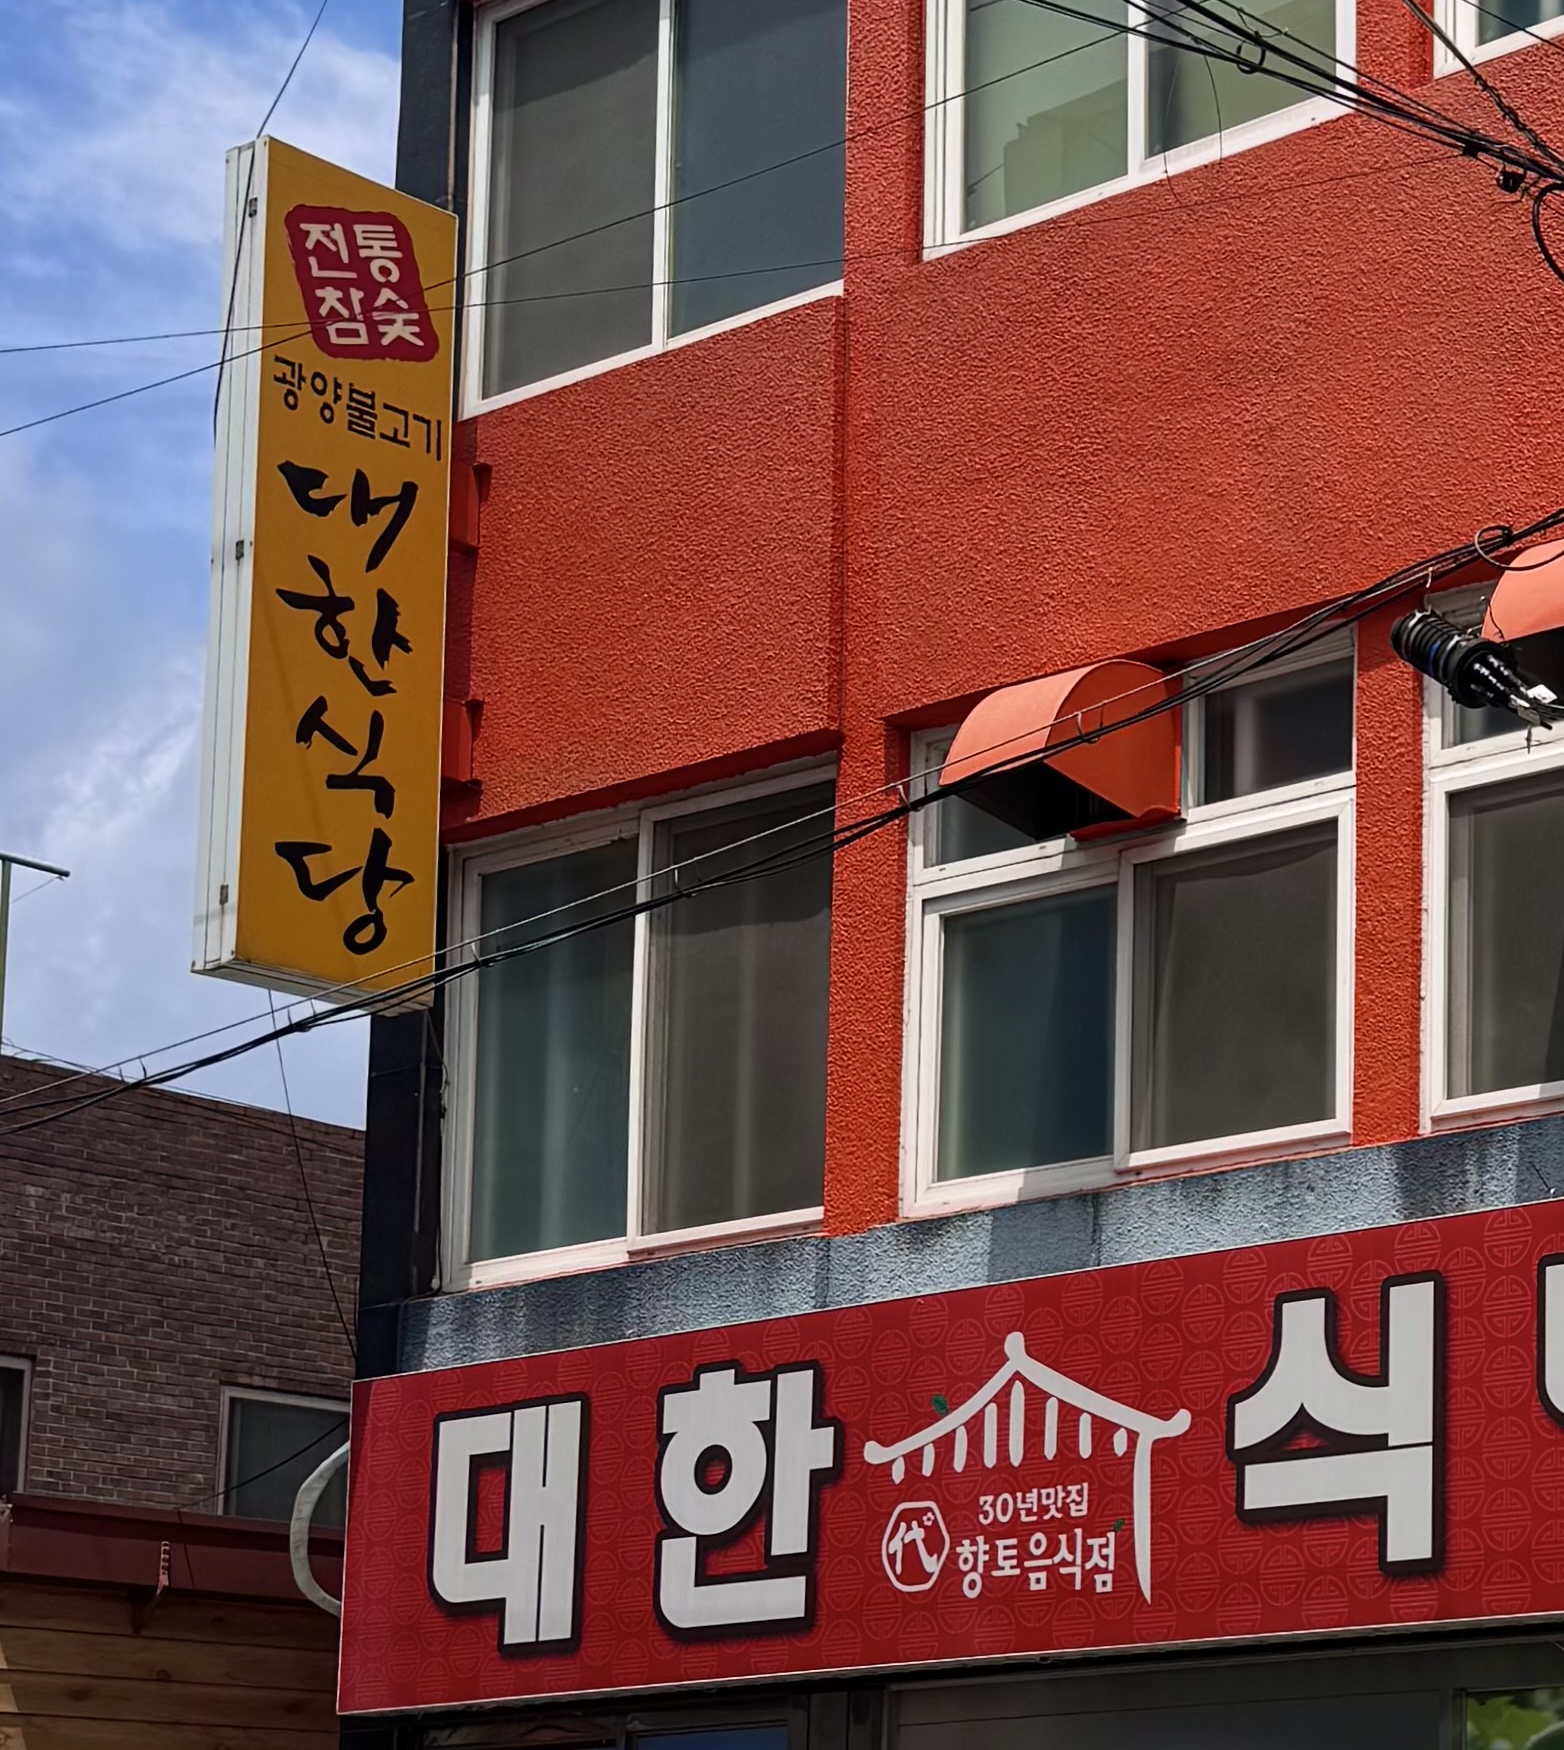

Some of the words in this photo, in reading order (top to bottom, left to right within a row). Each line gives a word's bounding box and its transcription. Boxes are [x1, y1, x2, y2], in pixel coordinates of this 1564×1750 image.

[299, 222, 403, 284] 전통
[314, 286, 425, 347] 참숯
[273, 354, 442, 462] 광양불고기
[275, 458, 420, 957] 대한식당
[978, 1482, 1089, 1526] 30년맛집
[955, 1529, 1117, 1599] 향토음식점
